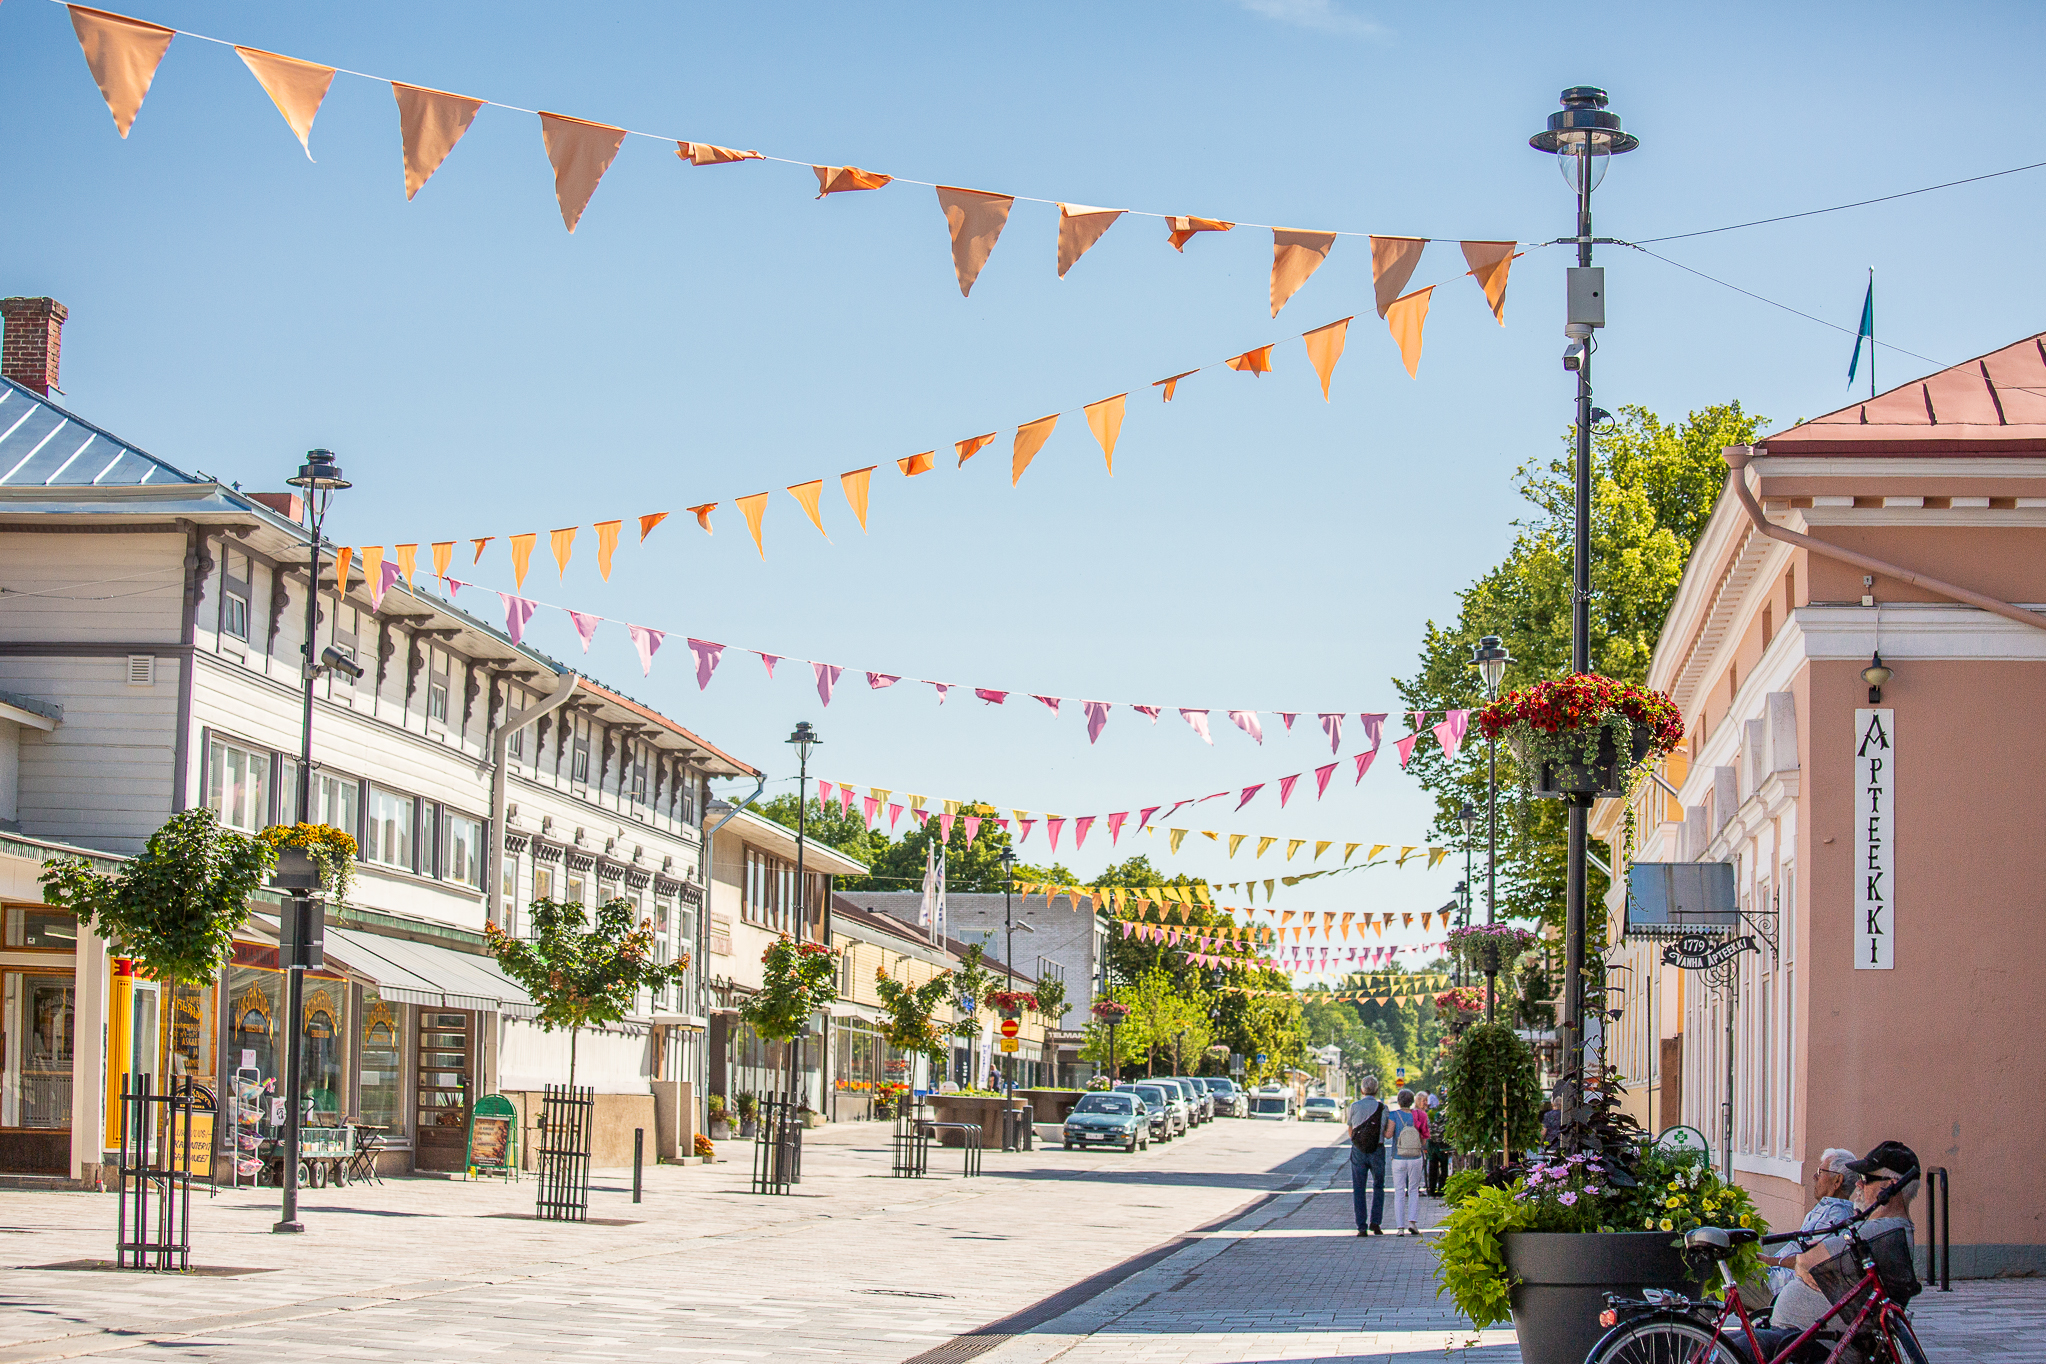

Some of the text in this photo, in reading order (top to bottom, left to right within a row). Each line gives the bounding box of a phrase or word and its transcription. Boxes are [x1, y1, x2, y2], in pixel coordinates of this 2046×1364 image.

[1857, 713, 1890, 964] APTEEKKI
[1668, 938, 1748, 968] VANHA APTEEKKI
[1683, 939, 1706, 952] 1779
